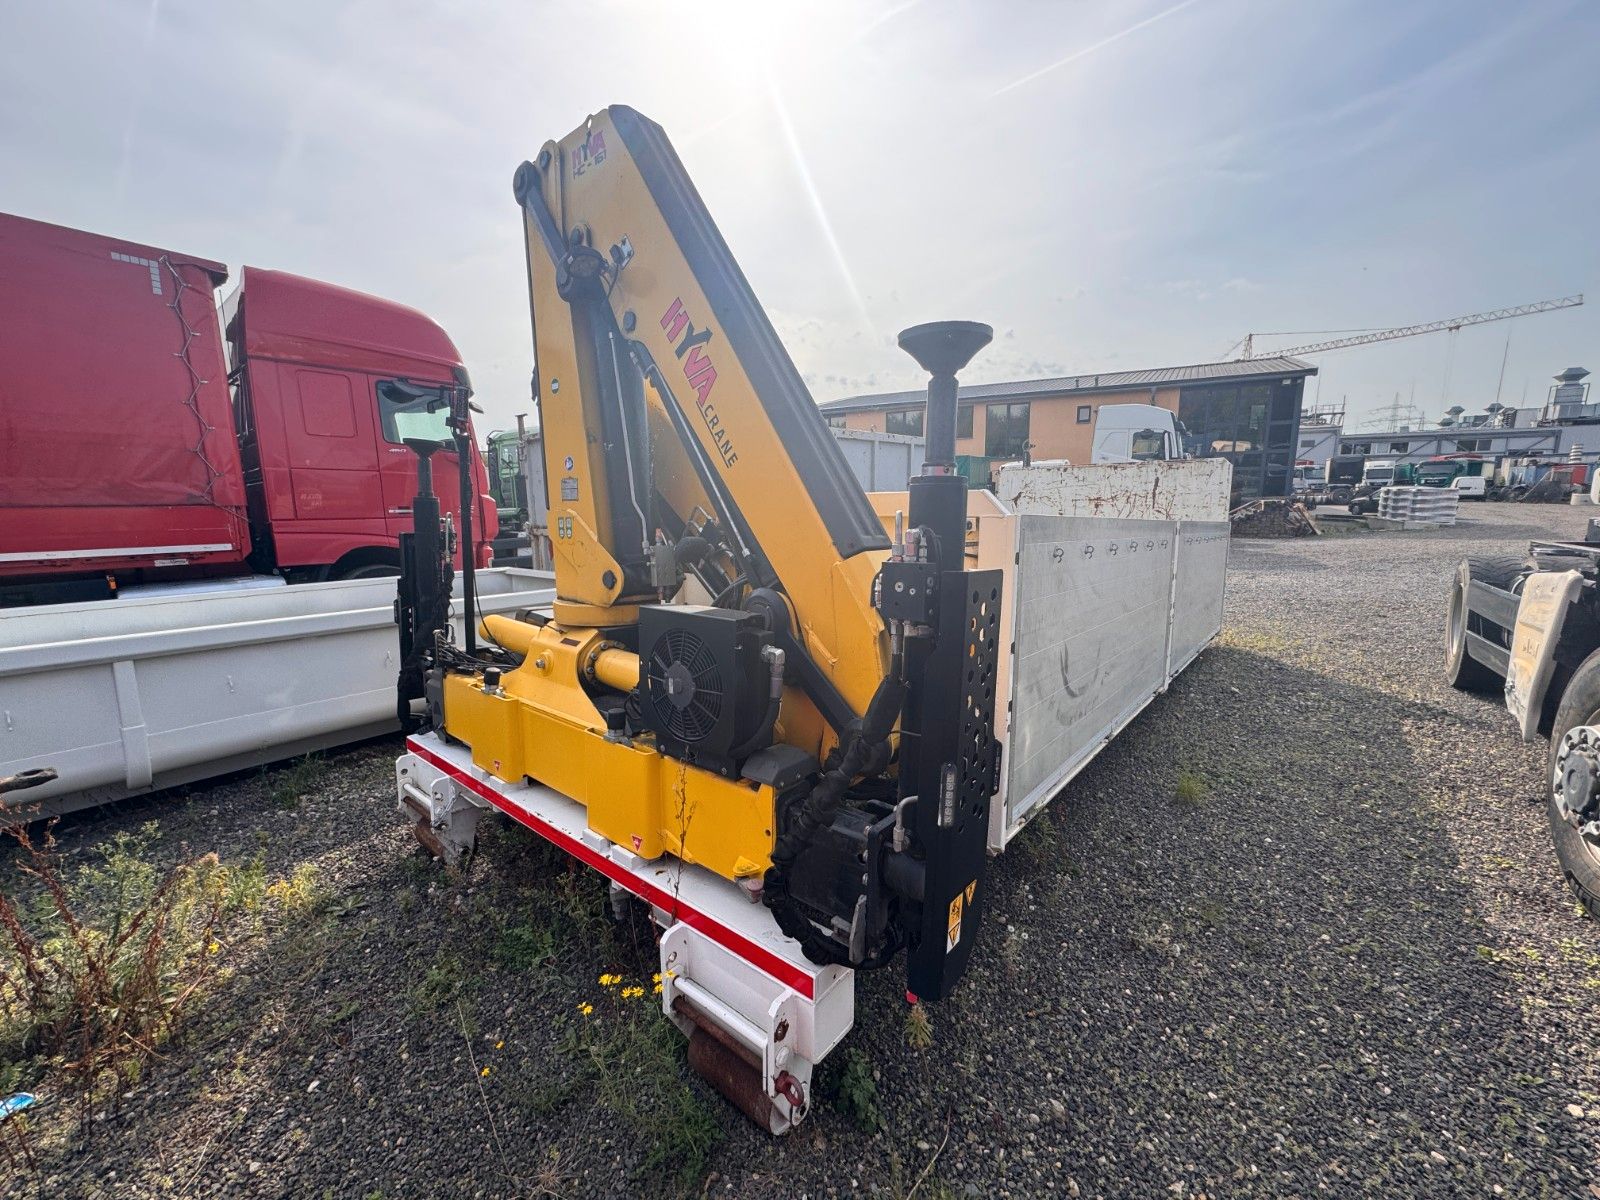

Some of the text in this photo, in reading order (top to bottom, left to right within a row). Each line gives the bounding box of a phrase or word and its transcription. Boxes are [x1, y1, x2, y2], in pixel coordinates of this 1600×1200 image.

[571, 128, 606, 170] HYVA
[660, 297, 739, 468] HYVA CRANE
